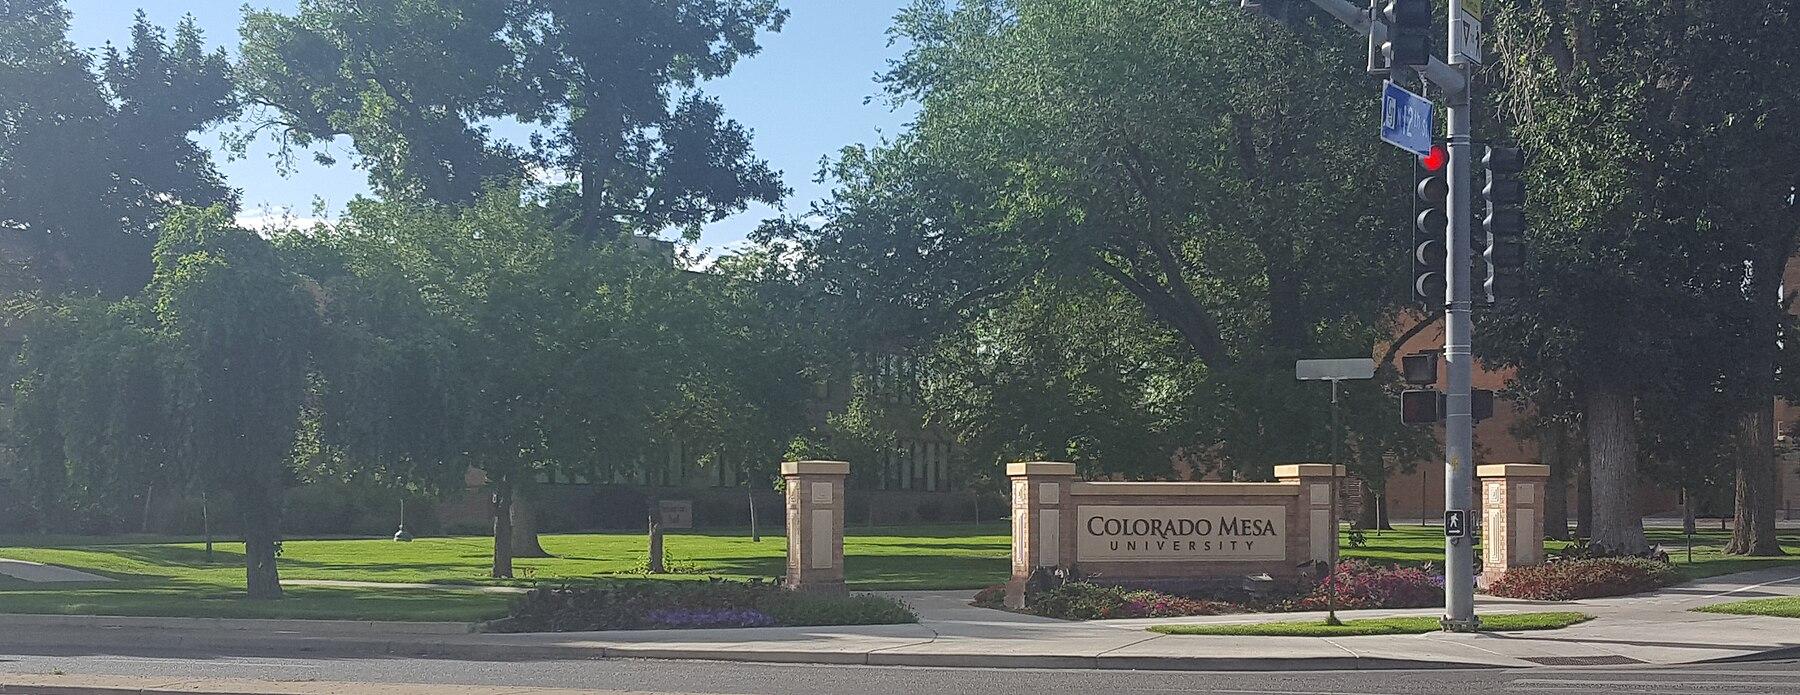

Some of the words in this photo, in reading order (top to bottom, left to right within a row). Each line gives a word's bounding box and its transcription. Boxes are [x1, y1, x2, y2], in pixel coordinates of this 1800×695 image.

[1087, 516, 1212, 539] COLORADO
[1218, 516, 1277, 536] MESA
[1110, 541, 1254, 551] UNIVERSITY
